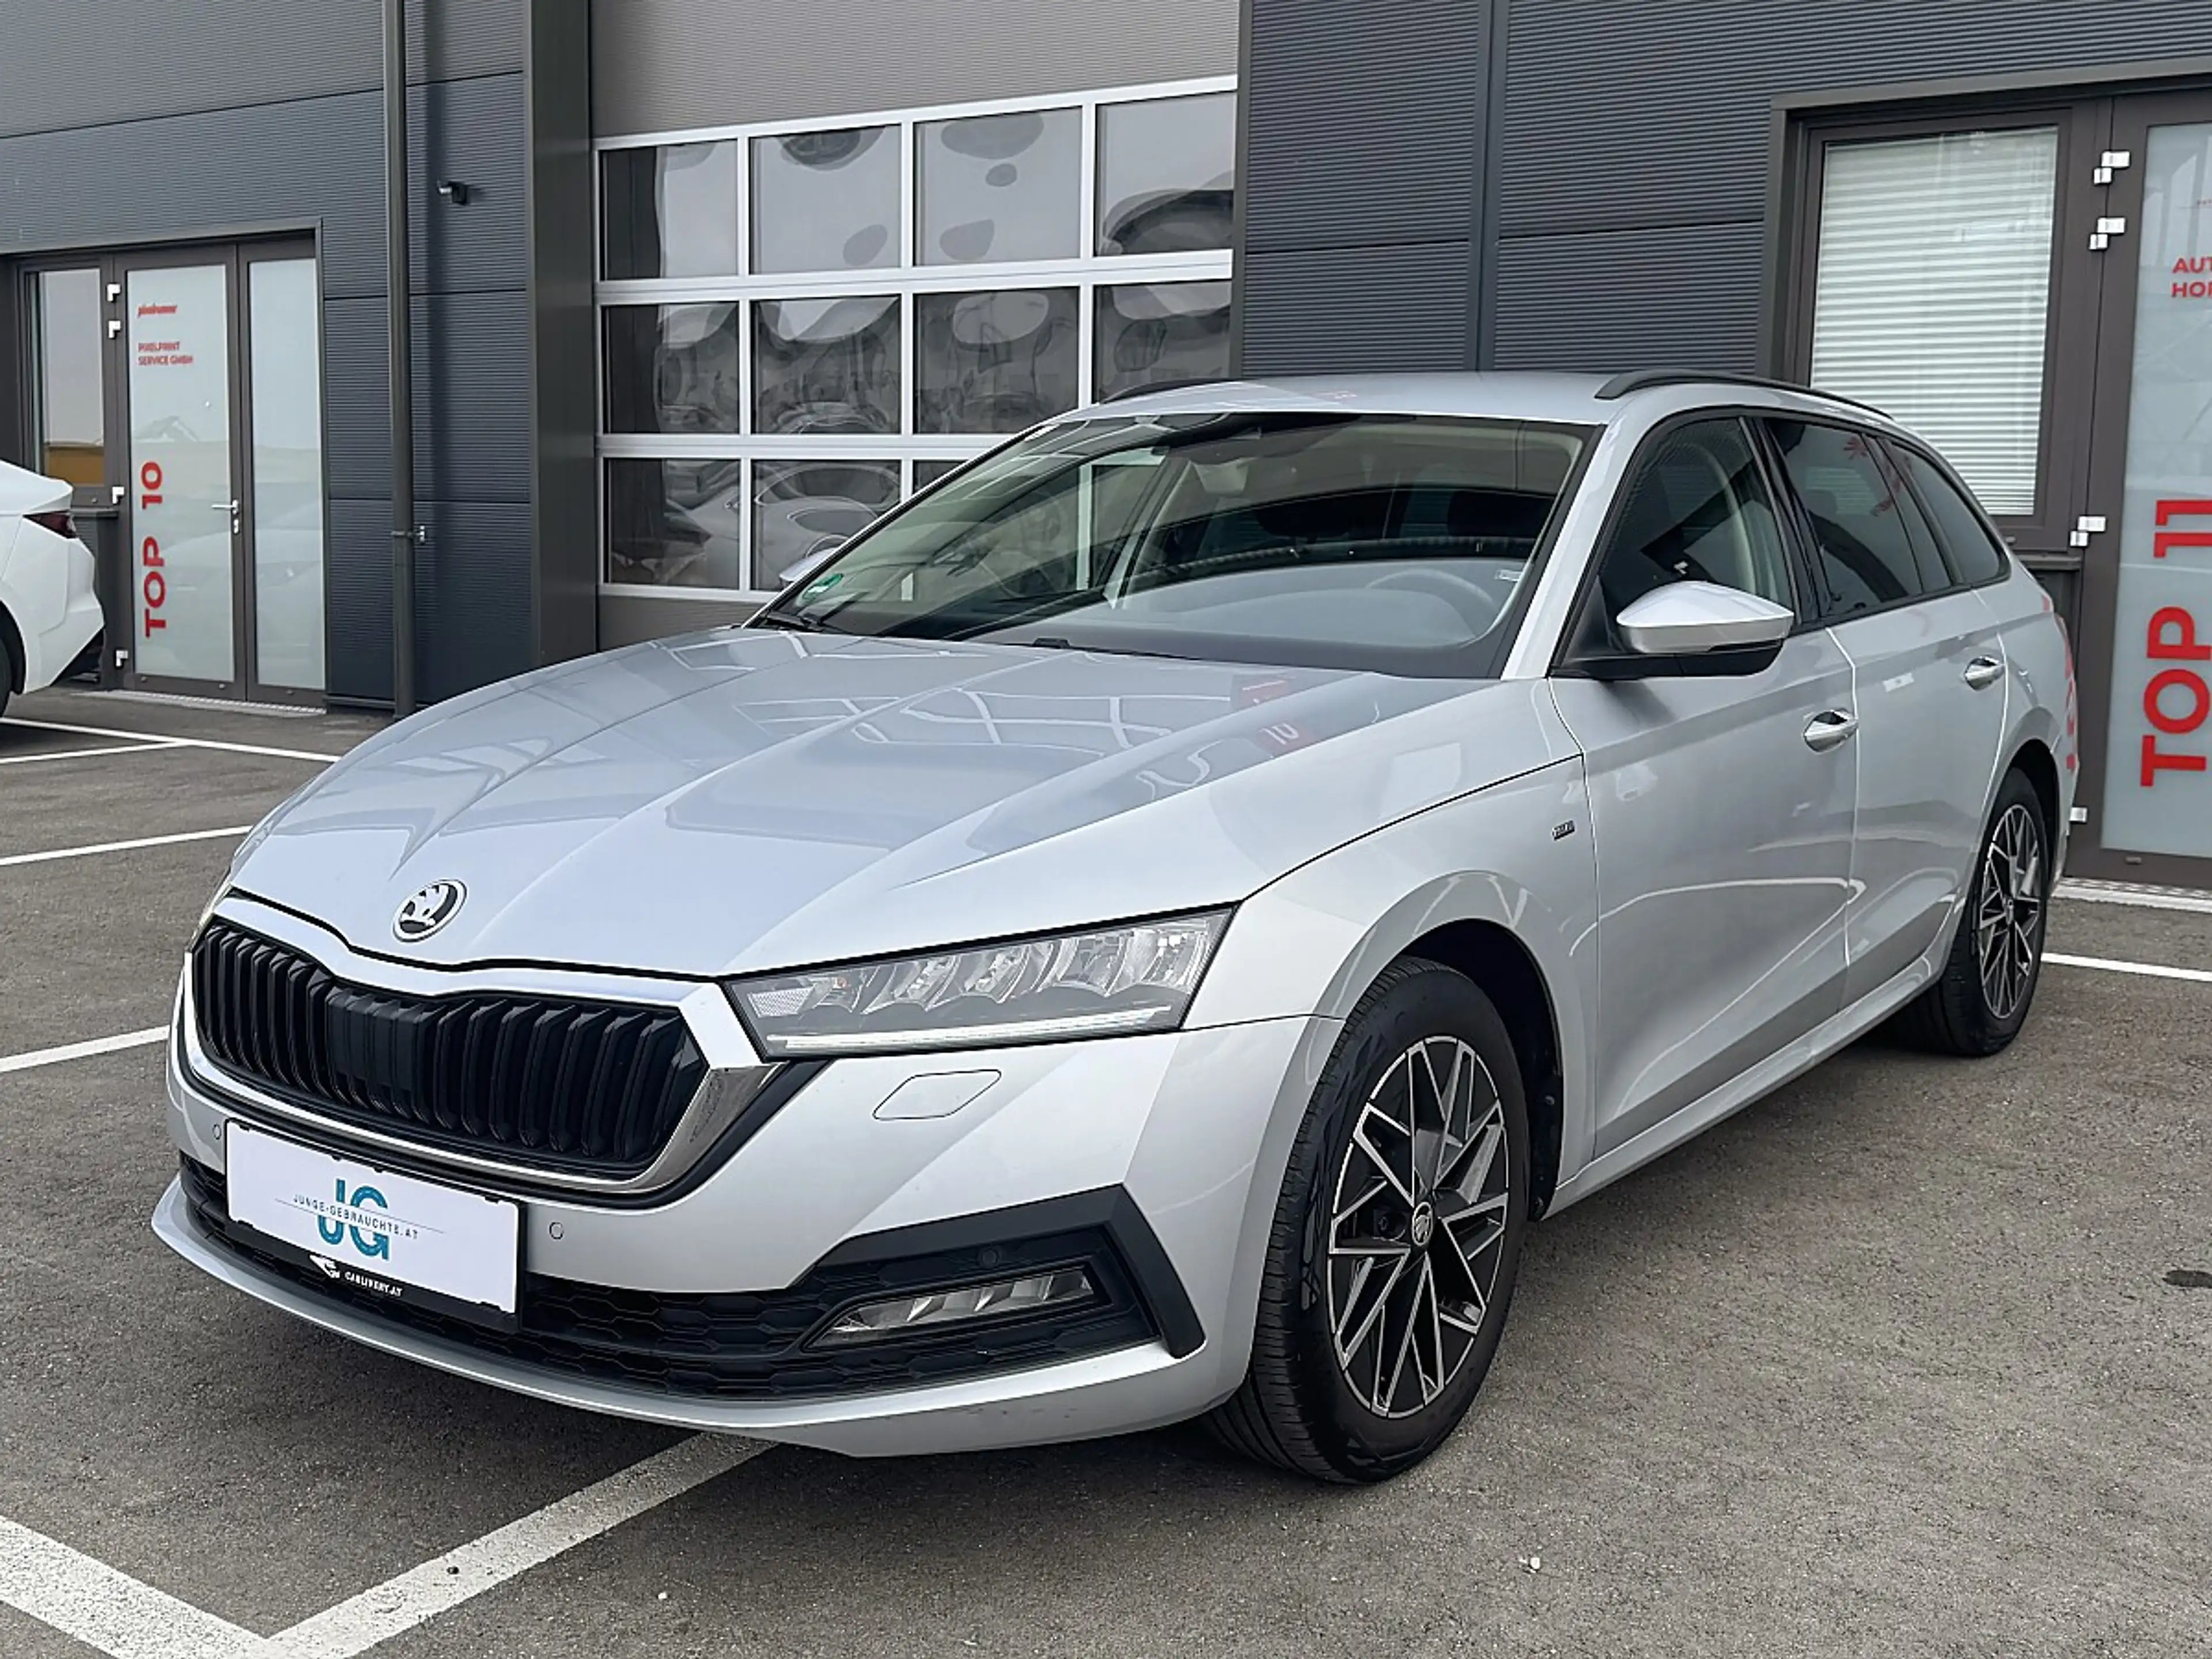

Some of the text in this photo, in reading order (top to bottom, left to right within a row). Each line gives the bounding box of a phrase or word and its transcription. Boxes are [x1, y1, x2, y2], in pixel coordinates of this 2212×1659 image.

[141, 461, 166, 638] TOP 10
[2140, 499, 2212, 787] TOP 11
